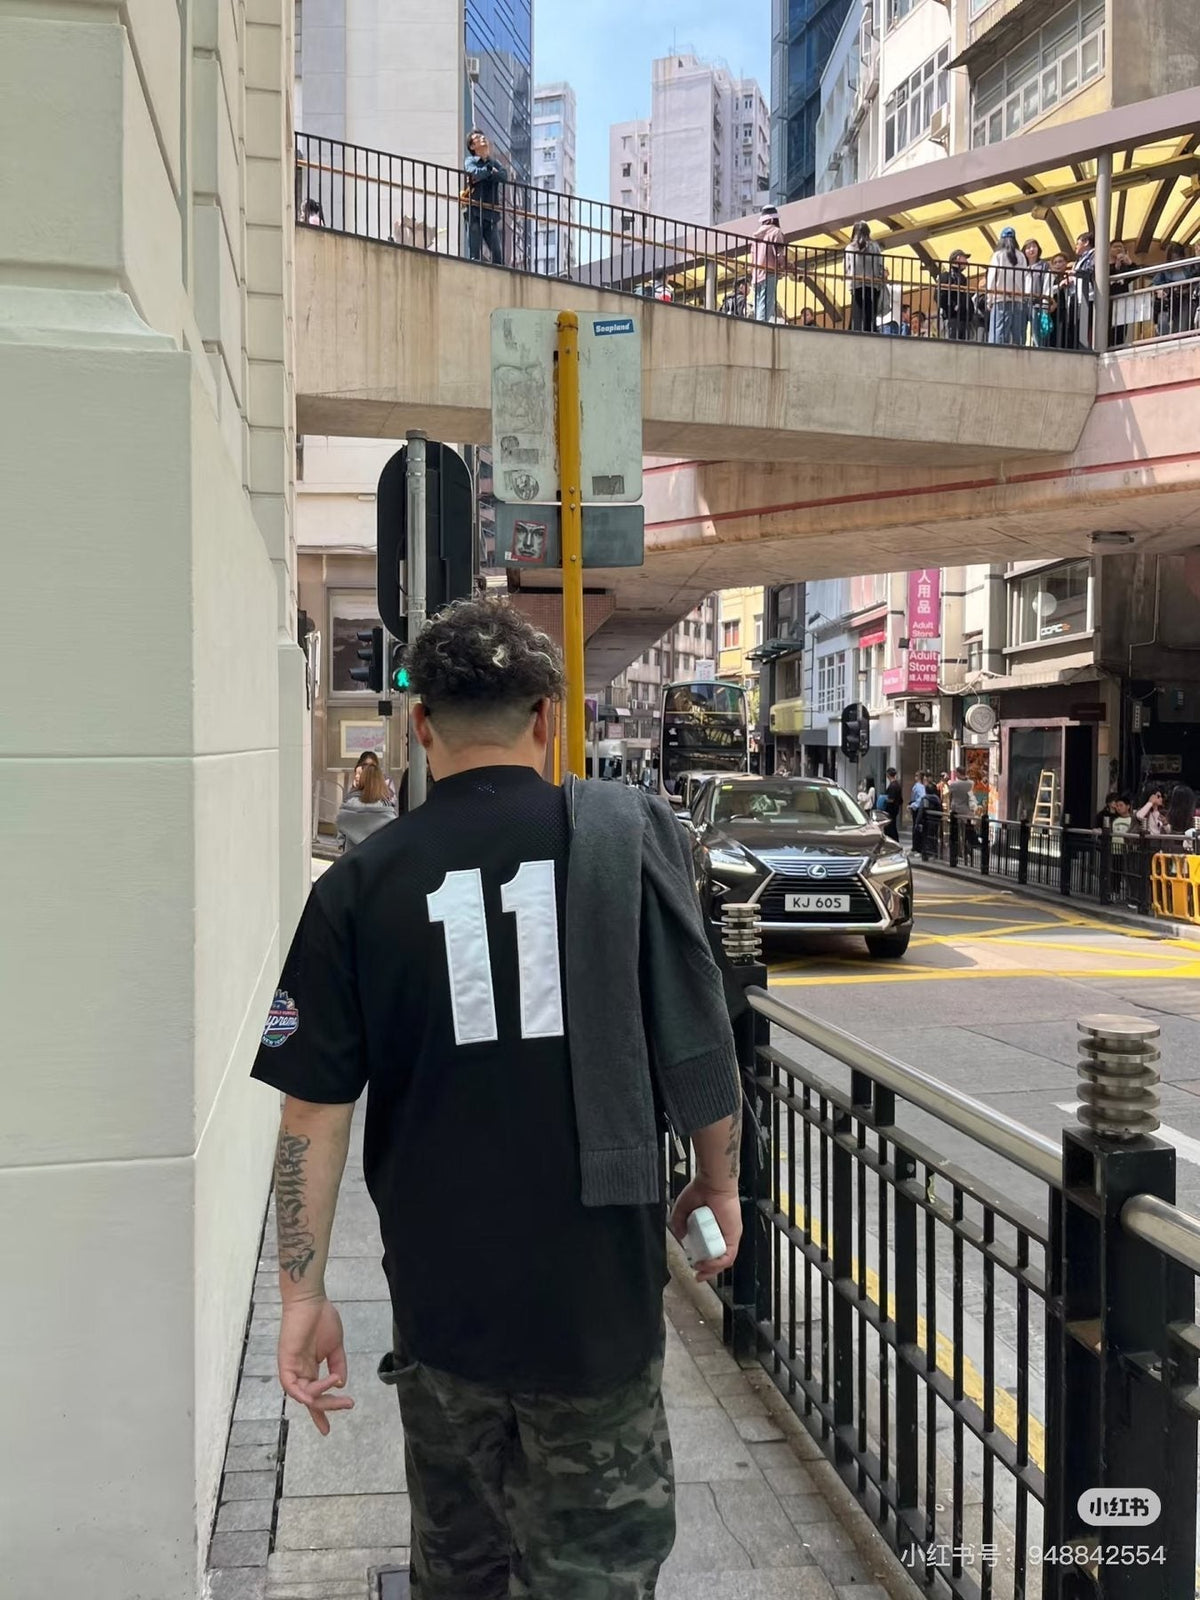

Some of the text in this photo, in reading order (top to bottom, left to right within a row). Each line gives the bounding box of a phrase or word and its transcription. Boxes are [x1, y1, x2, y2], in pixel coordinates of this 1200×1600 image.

[917, 569, 931, 614] 人用品
[912, 621, 934, 629] Adult
[912, 629, 934, 637] Store
[909, 651, 937, 660] Adult
[909, 662, 937, 672] Store
[793, 897, 842, 909] KJ 605
[426, 859, 564, 1045] 11
